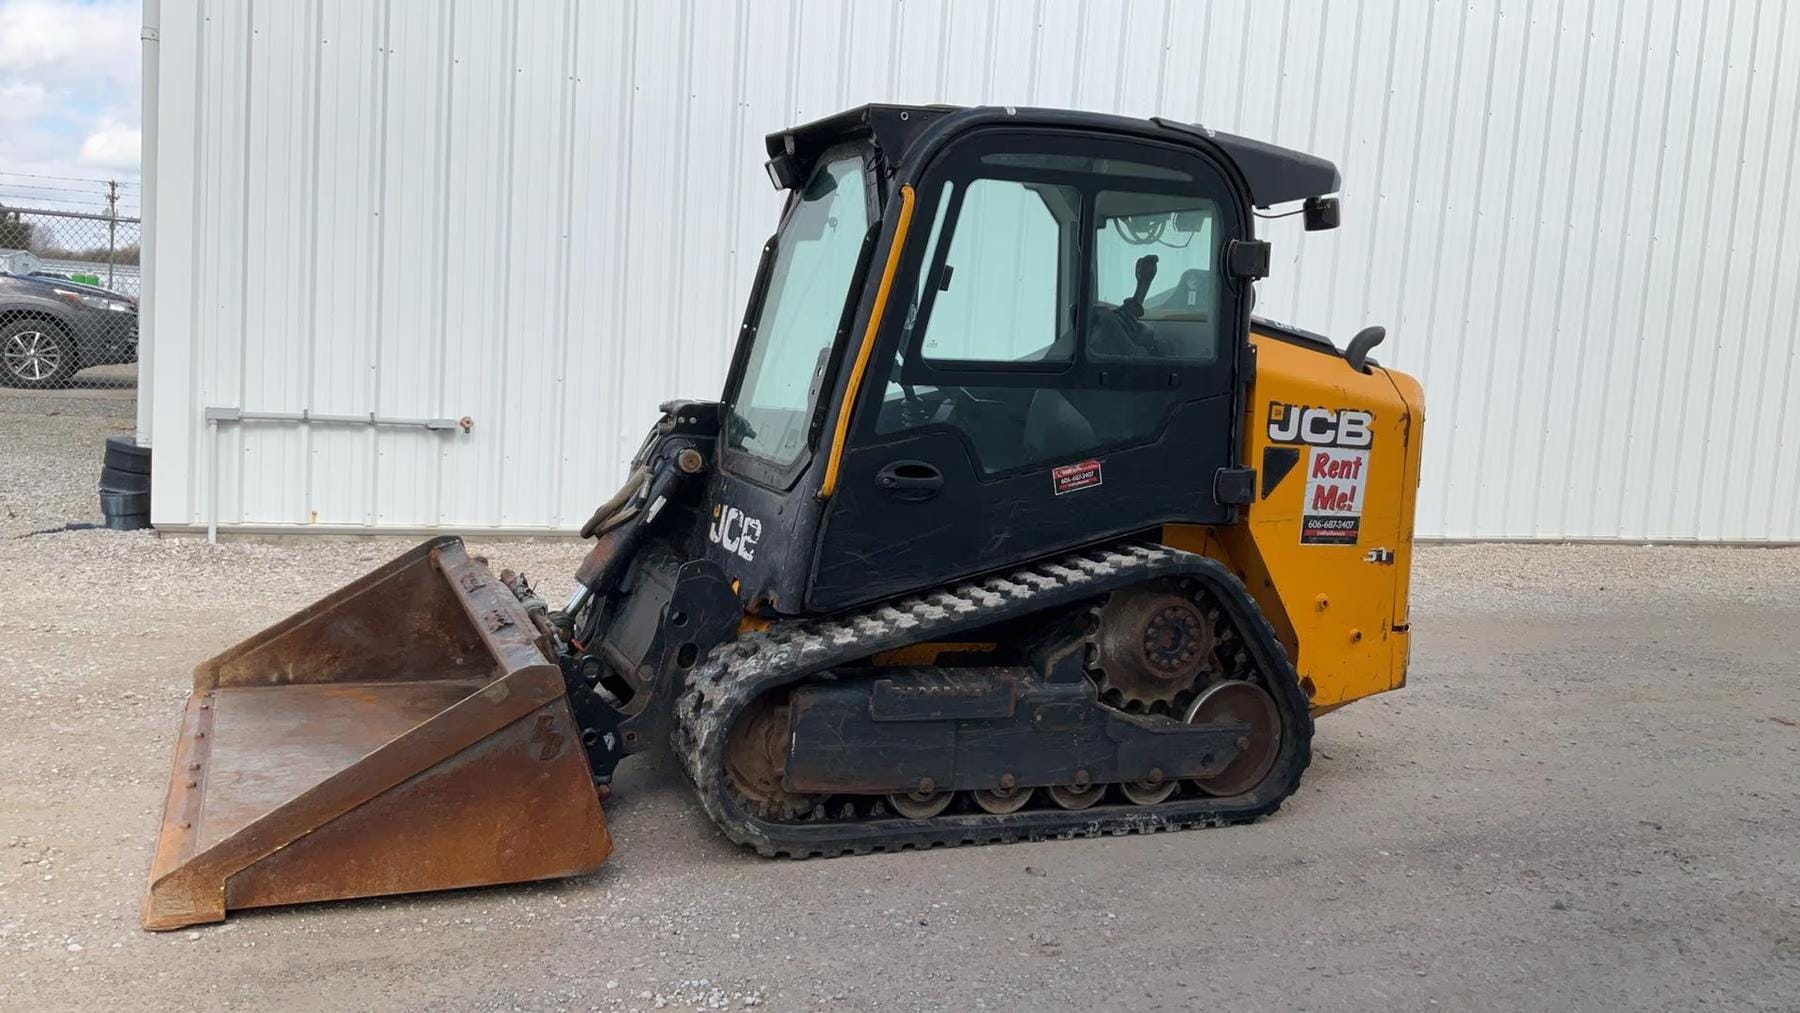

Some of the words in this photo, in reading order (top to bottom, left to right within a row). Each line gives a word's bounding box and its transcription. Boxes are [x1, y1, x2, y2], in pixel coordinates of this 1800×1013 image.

[1268, 404, 1372, 447] JCB
[1312, 452, 1362, 480] Rent
[1312, 484, 1357, 512] Me!
[1308, 519, 1355, 529] 606-687-3407
